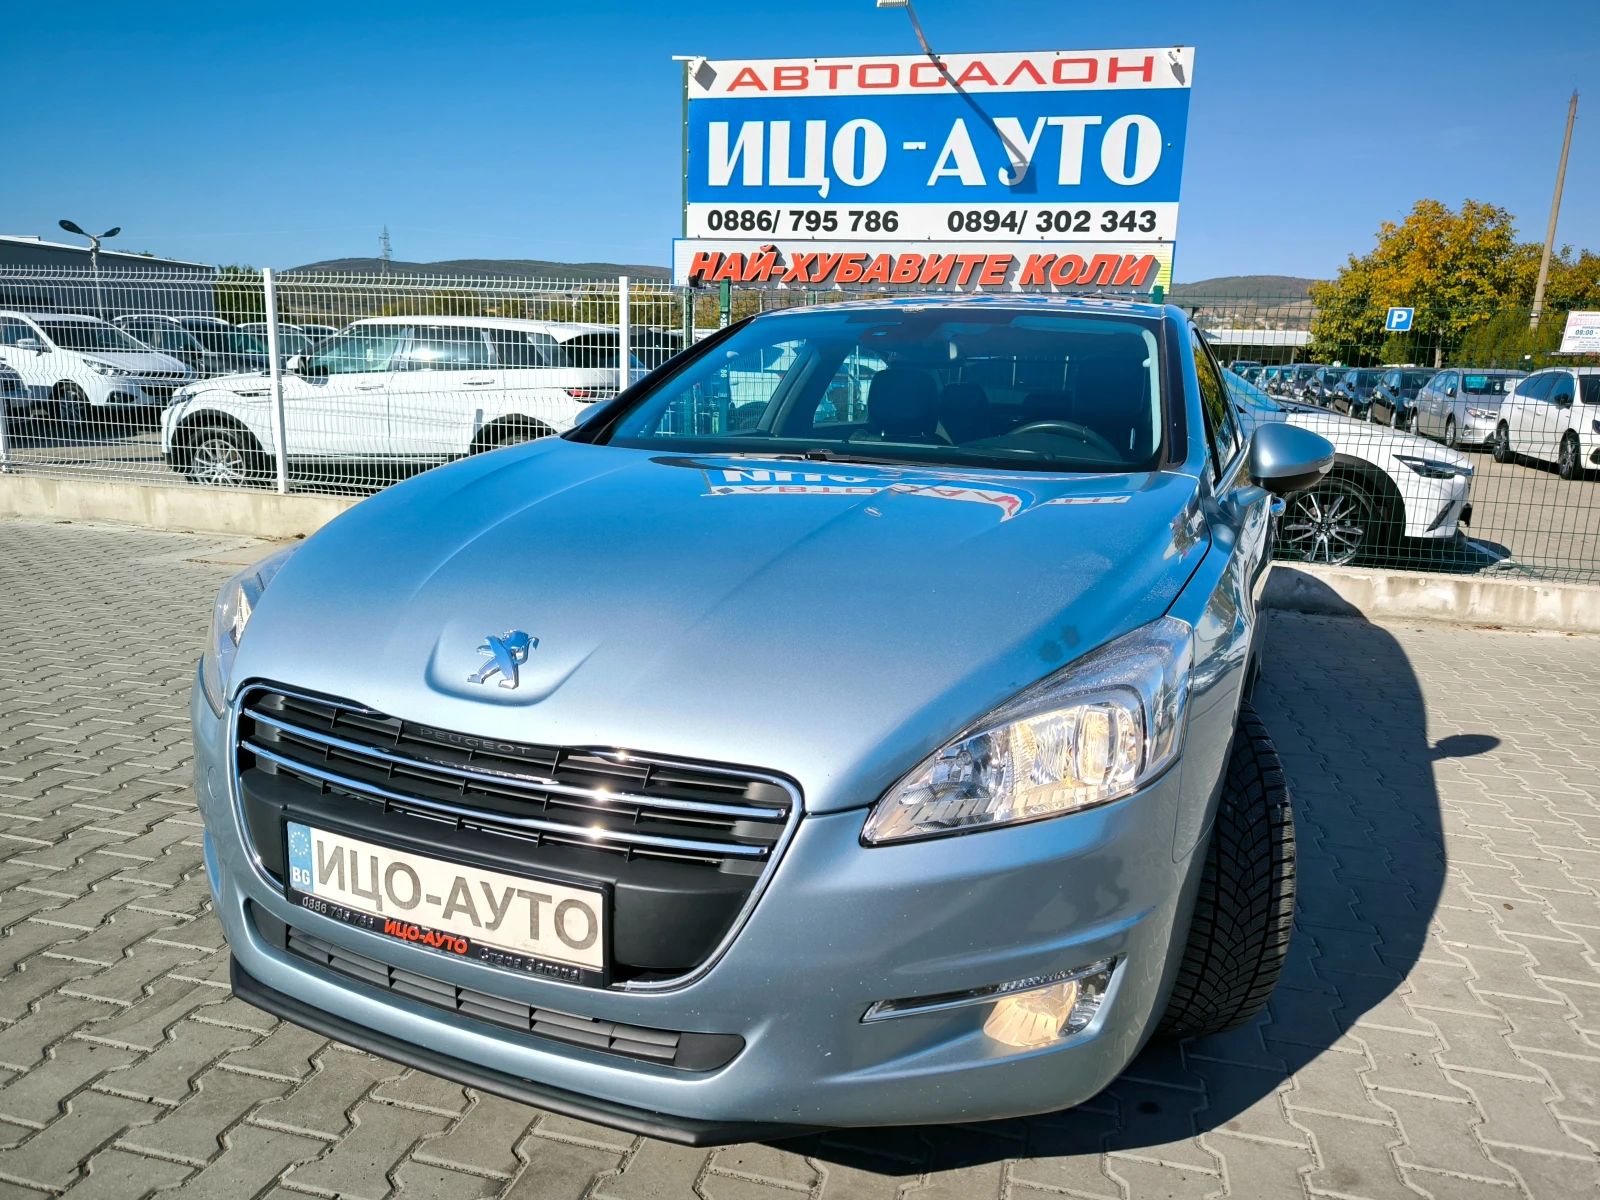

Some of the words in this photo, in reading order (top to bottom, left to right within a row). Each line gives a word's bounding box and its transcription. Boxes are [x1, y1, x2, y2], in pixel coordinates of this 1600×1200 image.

[726, 55, 1154, 92] АВТОСАЛОН
[707, 209, 781, 233] 0886/
[789, 209, 838, 233] 795
[849, 209, 899, 233] 786
[947, 209, 1028, 233] 0894/
[1035, 209, 1091, 233] 302
[1100, 209, 1157, 233] 343
[689, 244, 1012, 285] НАЙ-ХУБАВИТЕ
[1019, 253, 1156, 286] КОЛИ
[1390, 310, 1408, 328] P
[420, 728, 531, 754] PEUGEOT
[292, 866, 310, 885] BG
[316, 840, 599, 950] ИЦО-АУТО
[302, 896, 327, 914] 0886
[384, 920, 468, 954] ИЦО-АУТО
[479, 947, 523, 968] Стара
[526, 958, 580, 980] Загора
